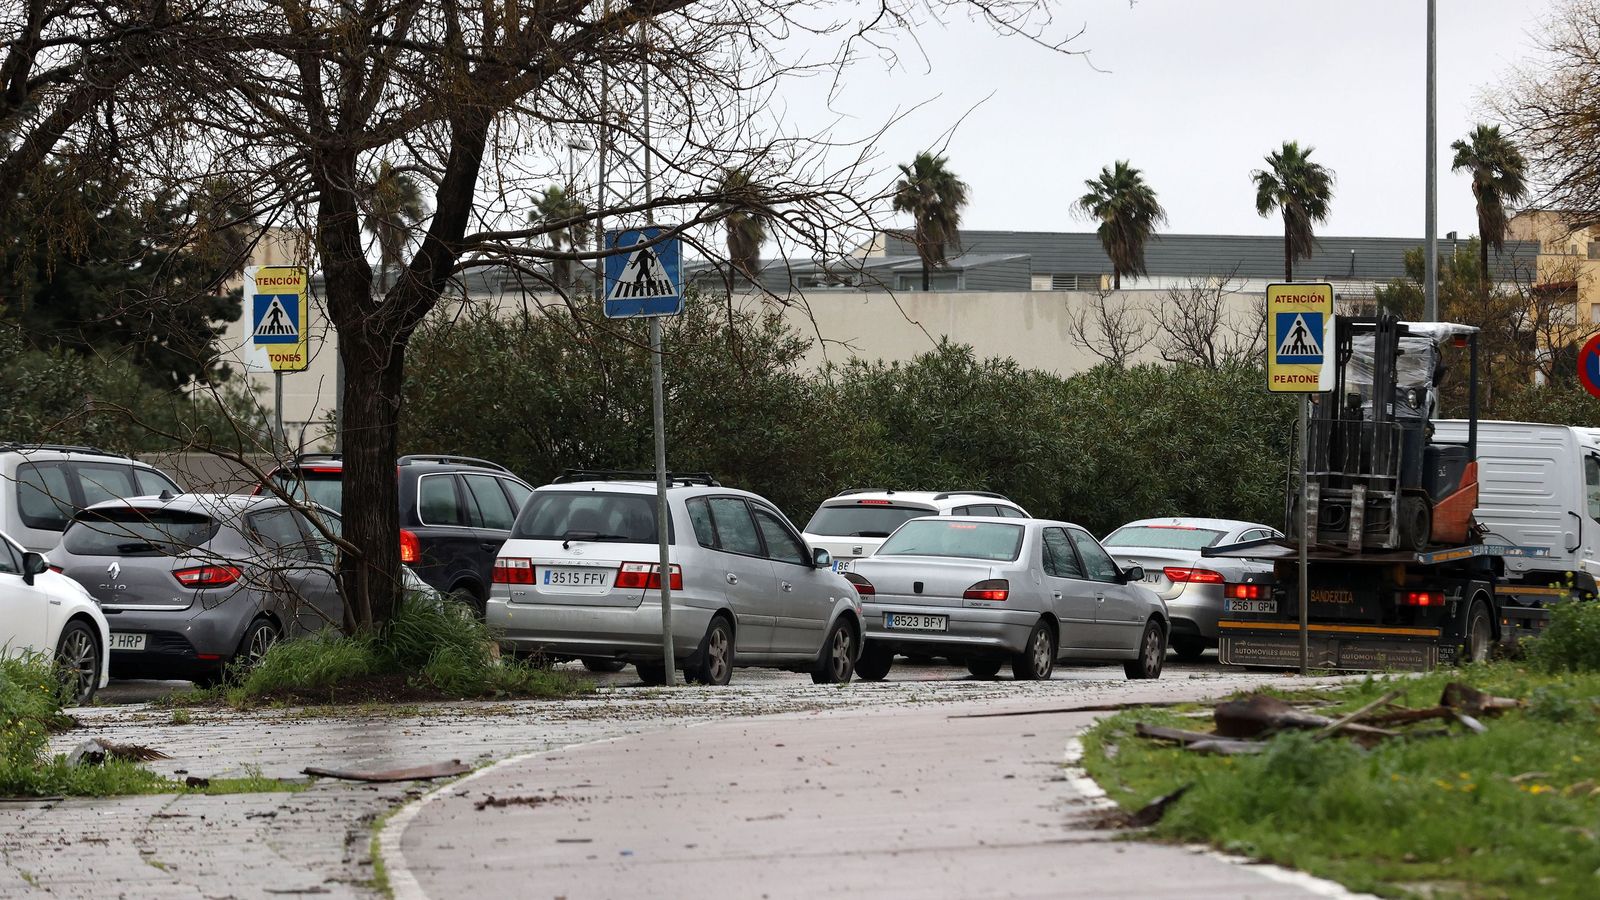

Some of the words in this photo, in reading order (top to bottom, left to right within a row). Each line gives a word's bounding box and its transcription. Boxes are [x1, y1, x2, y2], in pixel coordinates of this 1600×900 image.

[1274, 292, 1325, 304] ATENCIÓN
[552, 571, 580, 585] 3515
[583, 572, 607, 586] FFV
[1310, 589, 1354, 604] BANDERITA
[1231, 601, 1253, 611] 2561
[1257, 602, 1276, 612] GPM
[894, 615, 919, 627] 8523
[923, 617, 944, 629] BFY
[117, 634, 143, 648] HRP
[1234, 647, 1278, 657] AUTOMOVILES
